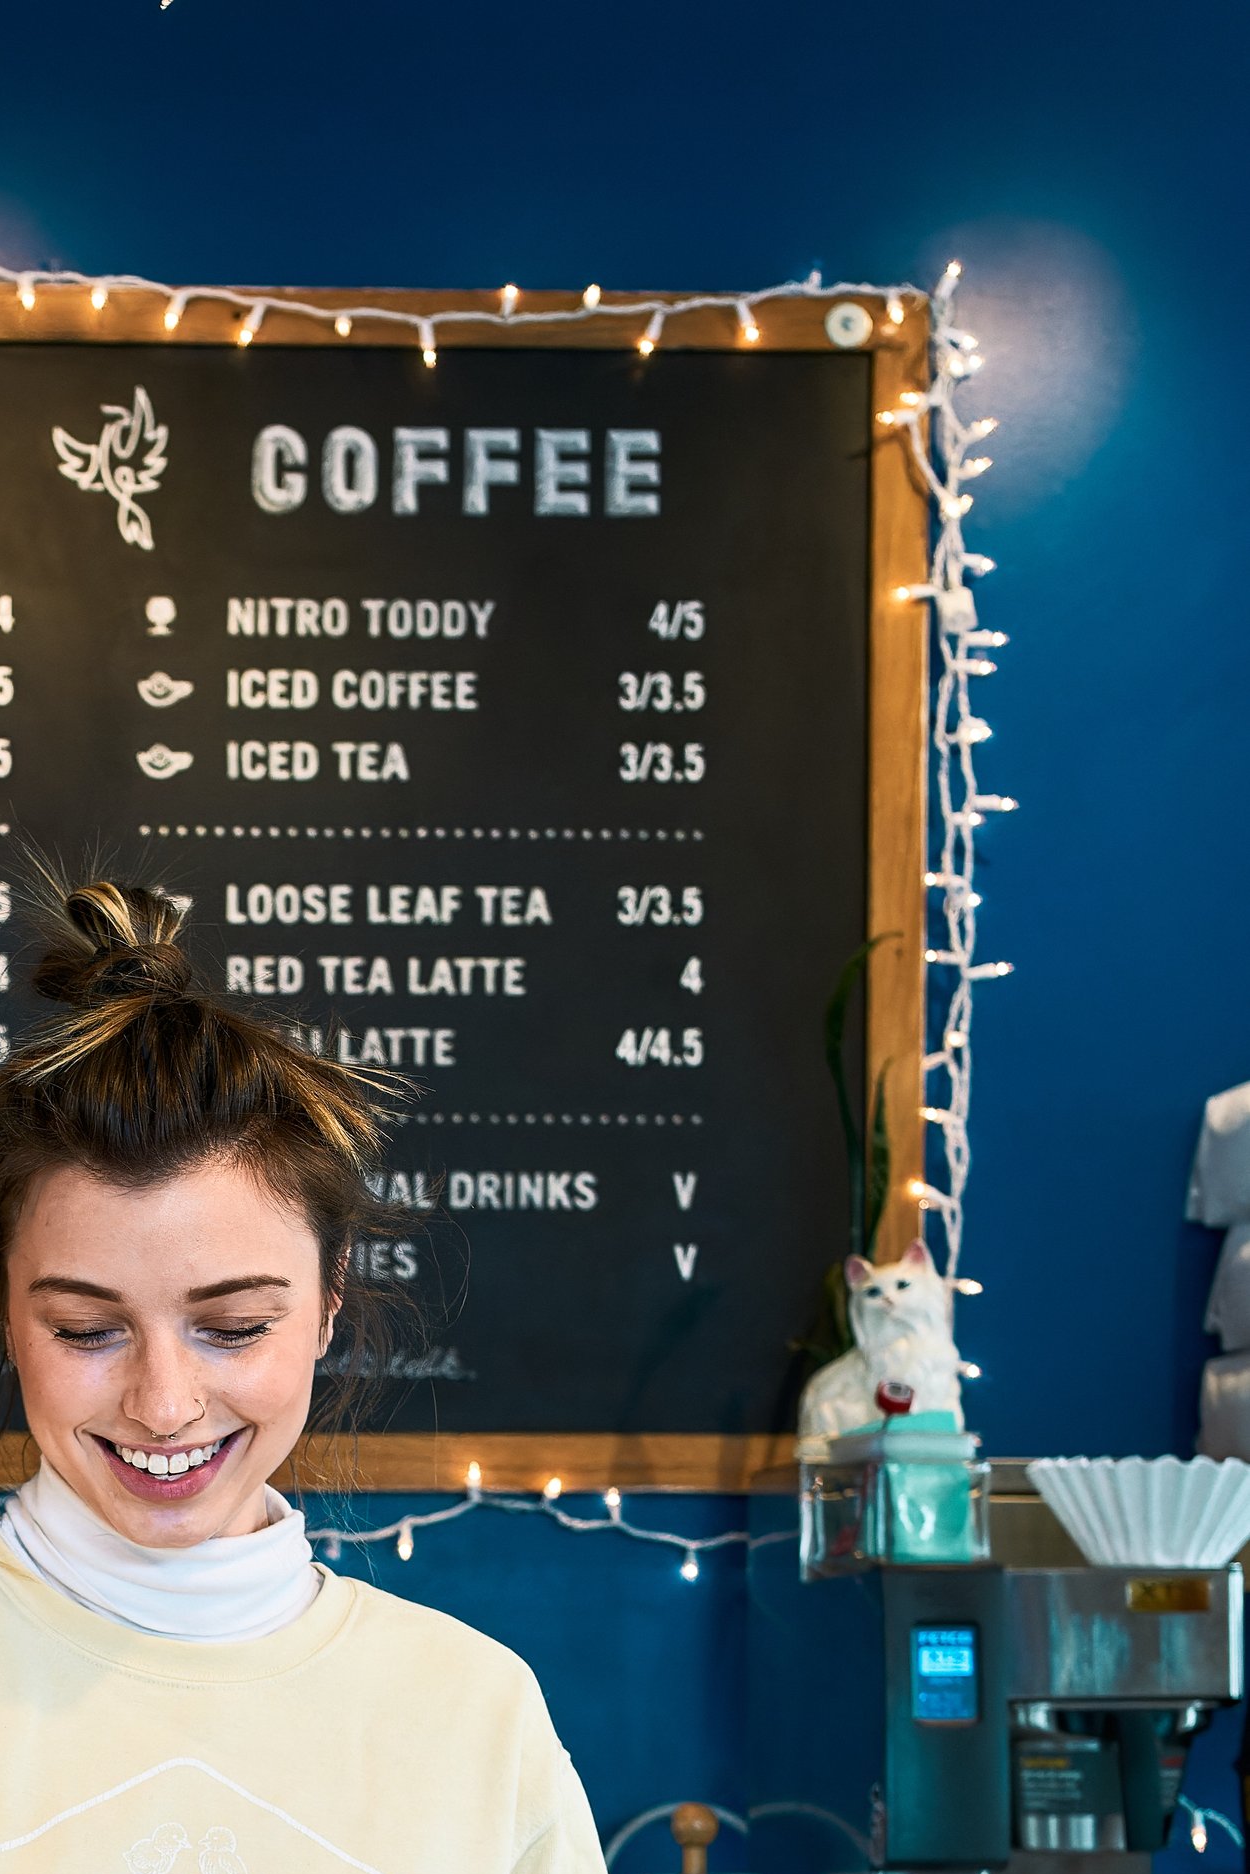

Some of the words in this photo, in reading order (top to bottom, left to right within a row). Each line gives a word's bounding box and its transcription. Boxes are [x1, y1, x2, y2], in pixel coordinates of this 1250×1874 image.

[251, 423, 662, 515] COFFEE
[225, 597, 349, 638] NITRO
[361, 599, 495, 639] TODDY
[648, 600, 705, 641] 4/5
[226, 668, 320, 709] ICED
[332, 669, 477, 710] COFFEE
[617, 671, 706, 712] 3/3.5
[226, 740, 320, 781] ICED
[331, 741, 410, 782] TEA
[618, 742, 706, 783] 3/3.5
[225, 883, 353, 924] LOOSE
[367, 884, 462, 924] LEAF
[475, 885, 552, 925] TEA
[616, 885, 704, 926] 3/3.5
[225, 954, 305, 995] RED
[317, 955, 394, 995] TEA
[407, 956, 526, 996] LATTE
[680, 957, 704, 994] 4
[338, 1027, 456, 1067] LATTE
[615, 1027, 704, 1067] 4/4.5
[449, 1172, 598, 1210] DRINKS
[672, 1172, 697, 1210] V
[673, 1244, 697, 1281] V
